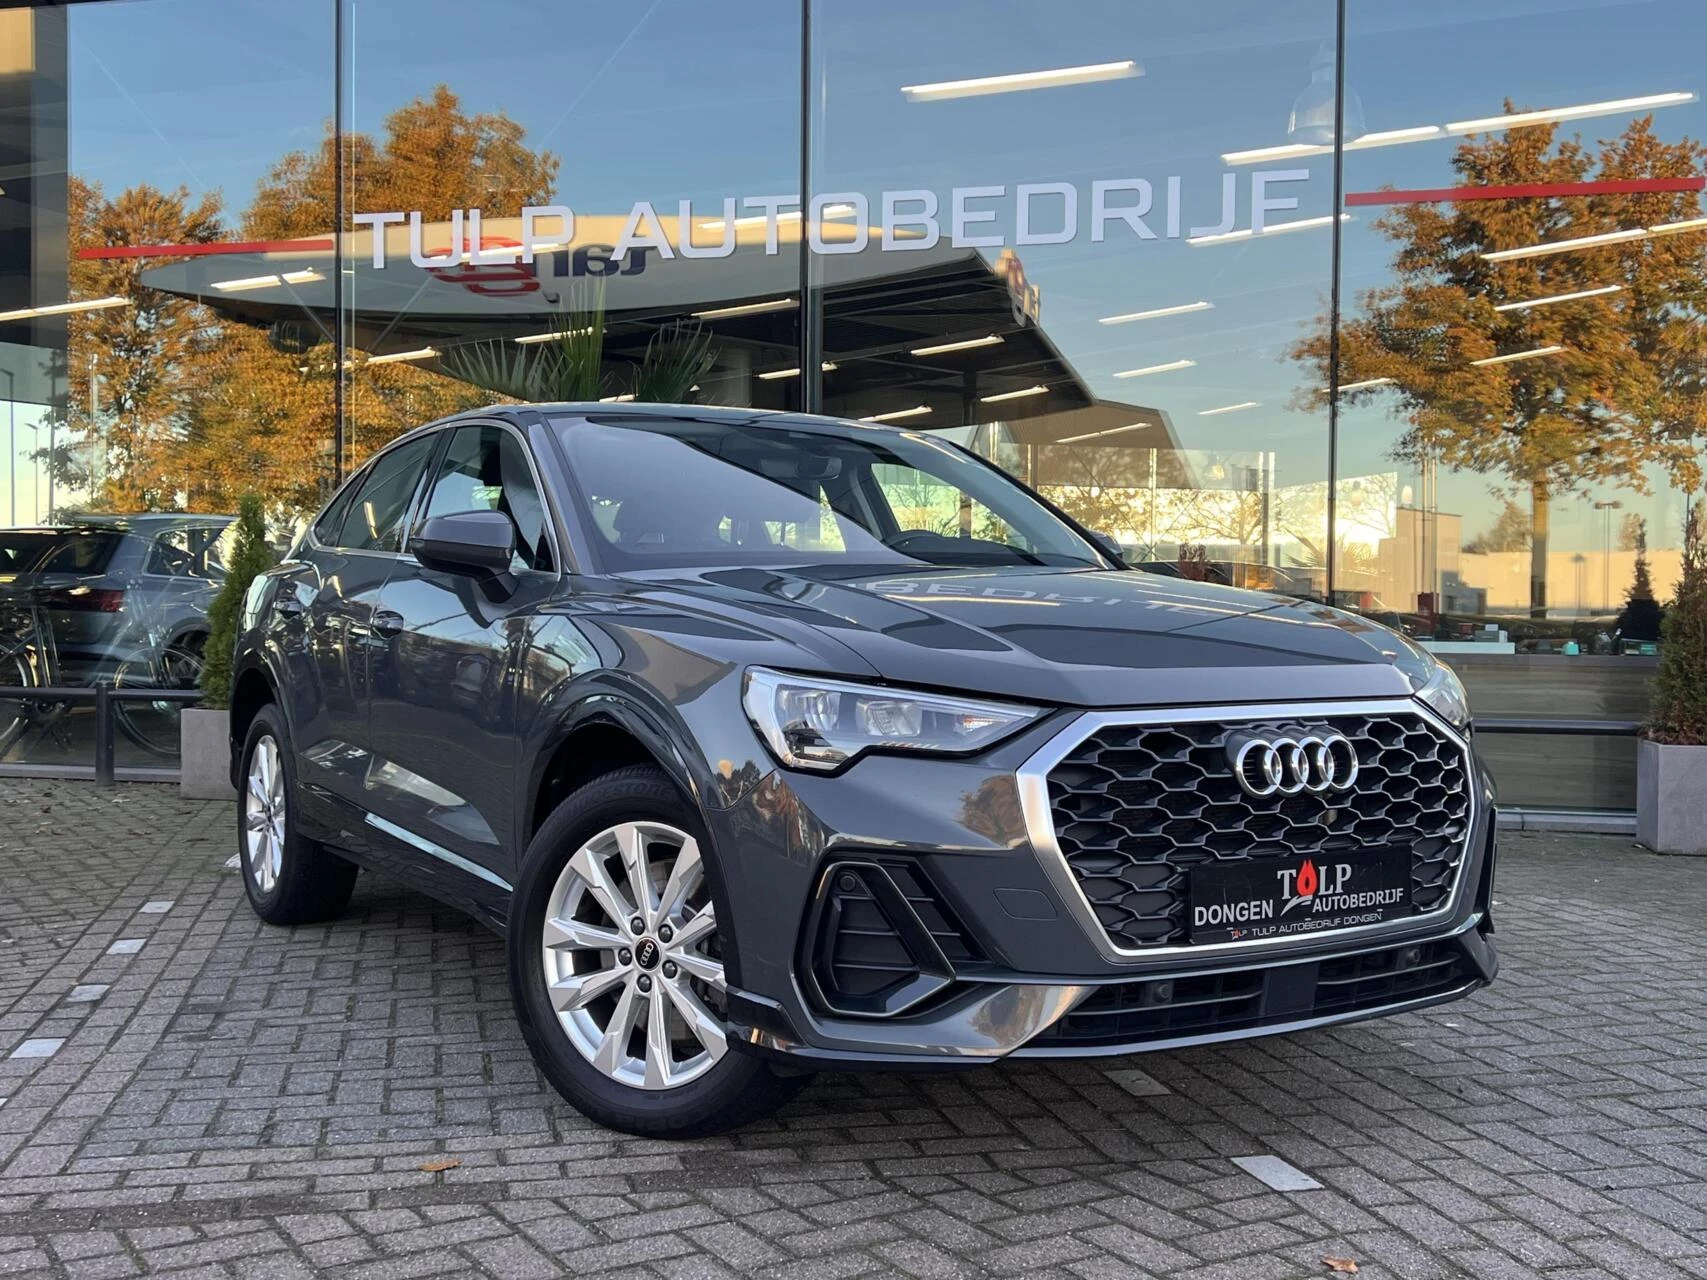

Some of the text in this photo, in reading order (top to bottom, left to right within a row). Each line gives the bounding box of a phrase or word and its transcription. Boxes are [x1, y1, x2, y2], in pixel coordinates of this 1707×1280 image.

[353, 168, 1310, 269] TULP AUTOBEDRIJF
[1195, 900, 1273, 926] DONGEN
[1312, 888, 1404, 913] AUTOBEDRIJF
[1252, 926, 1277, 937] TULP
[1278, 917, 1341, 933] AUTOBEDRIJF
[1343, 912, 1382, 925] DONGEN
